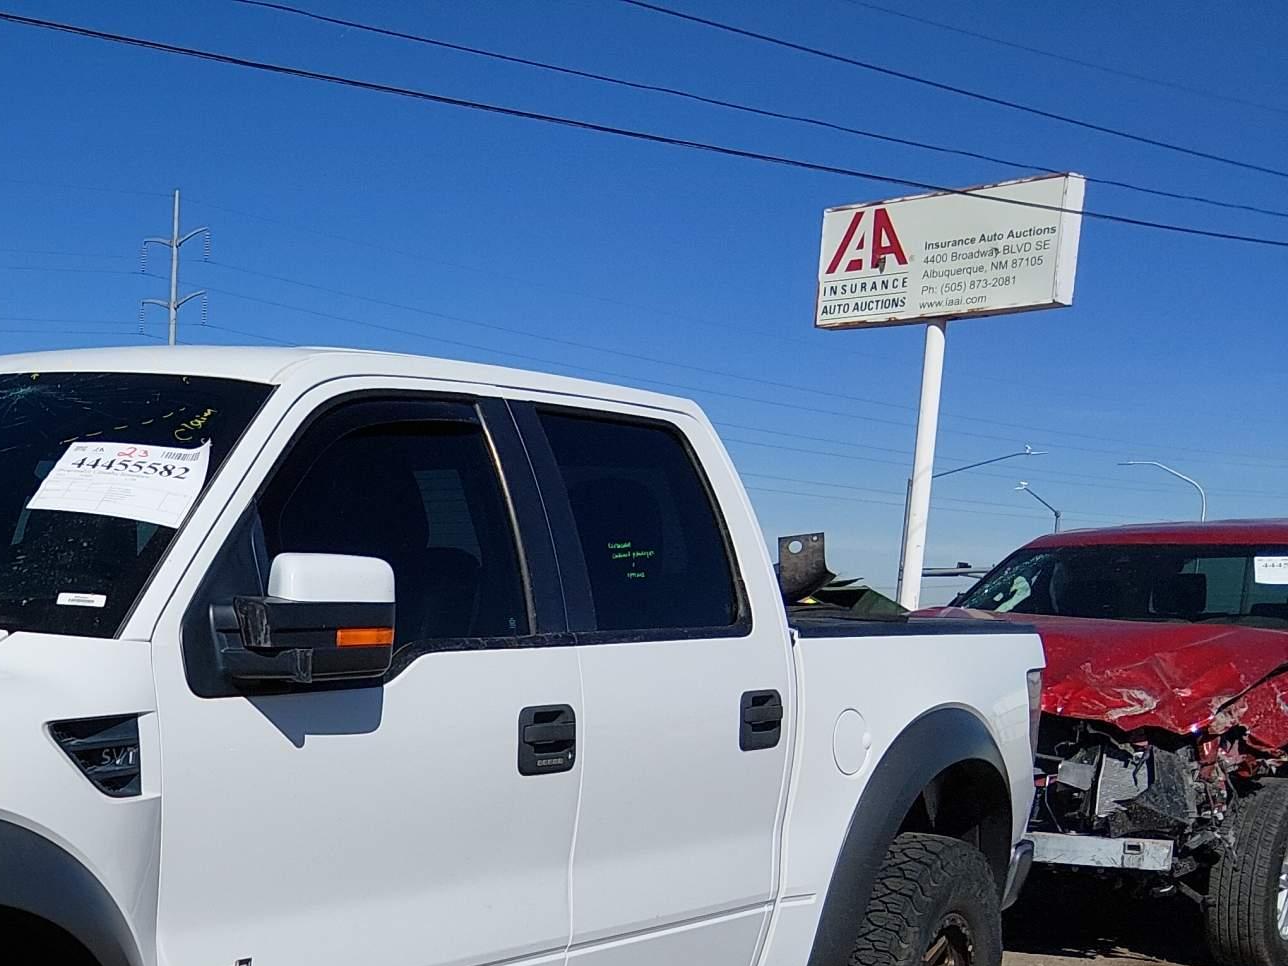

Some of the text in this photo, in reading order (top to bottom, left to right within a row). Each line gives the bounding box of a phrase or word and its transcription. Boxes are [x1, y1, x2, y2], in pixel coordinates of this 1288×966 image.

[924, 224, 1057, 251] Insurance Auto Auctions
[923, 252, 948, 265] 4400
[1003, 241, 1032, 256] BLVD
[1034, 239, 1051, 252] SE
[990, 257, 1009, 272] NM
[1011, 255, 1044, 270] 87105
[823, 277, 909, 297] INSURANCE
[921, 276, 1017, 296] Ph: (505) 873-2081
[821, 296, 907, 316] AUTO AUCTIONS
[919, 294, 987, 310] www.iaai.com
[117, 446, 150, 459] 23
[71, 456, 191, 480] 44455582
[101, 746, 138, 765] SVT
